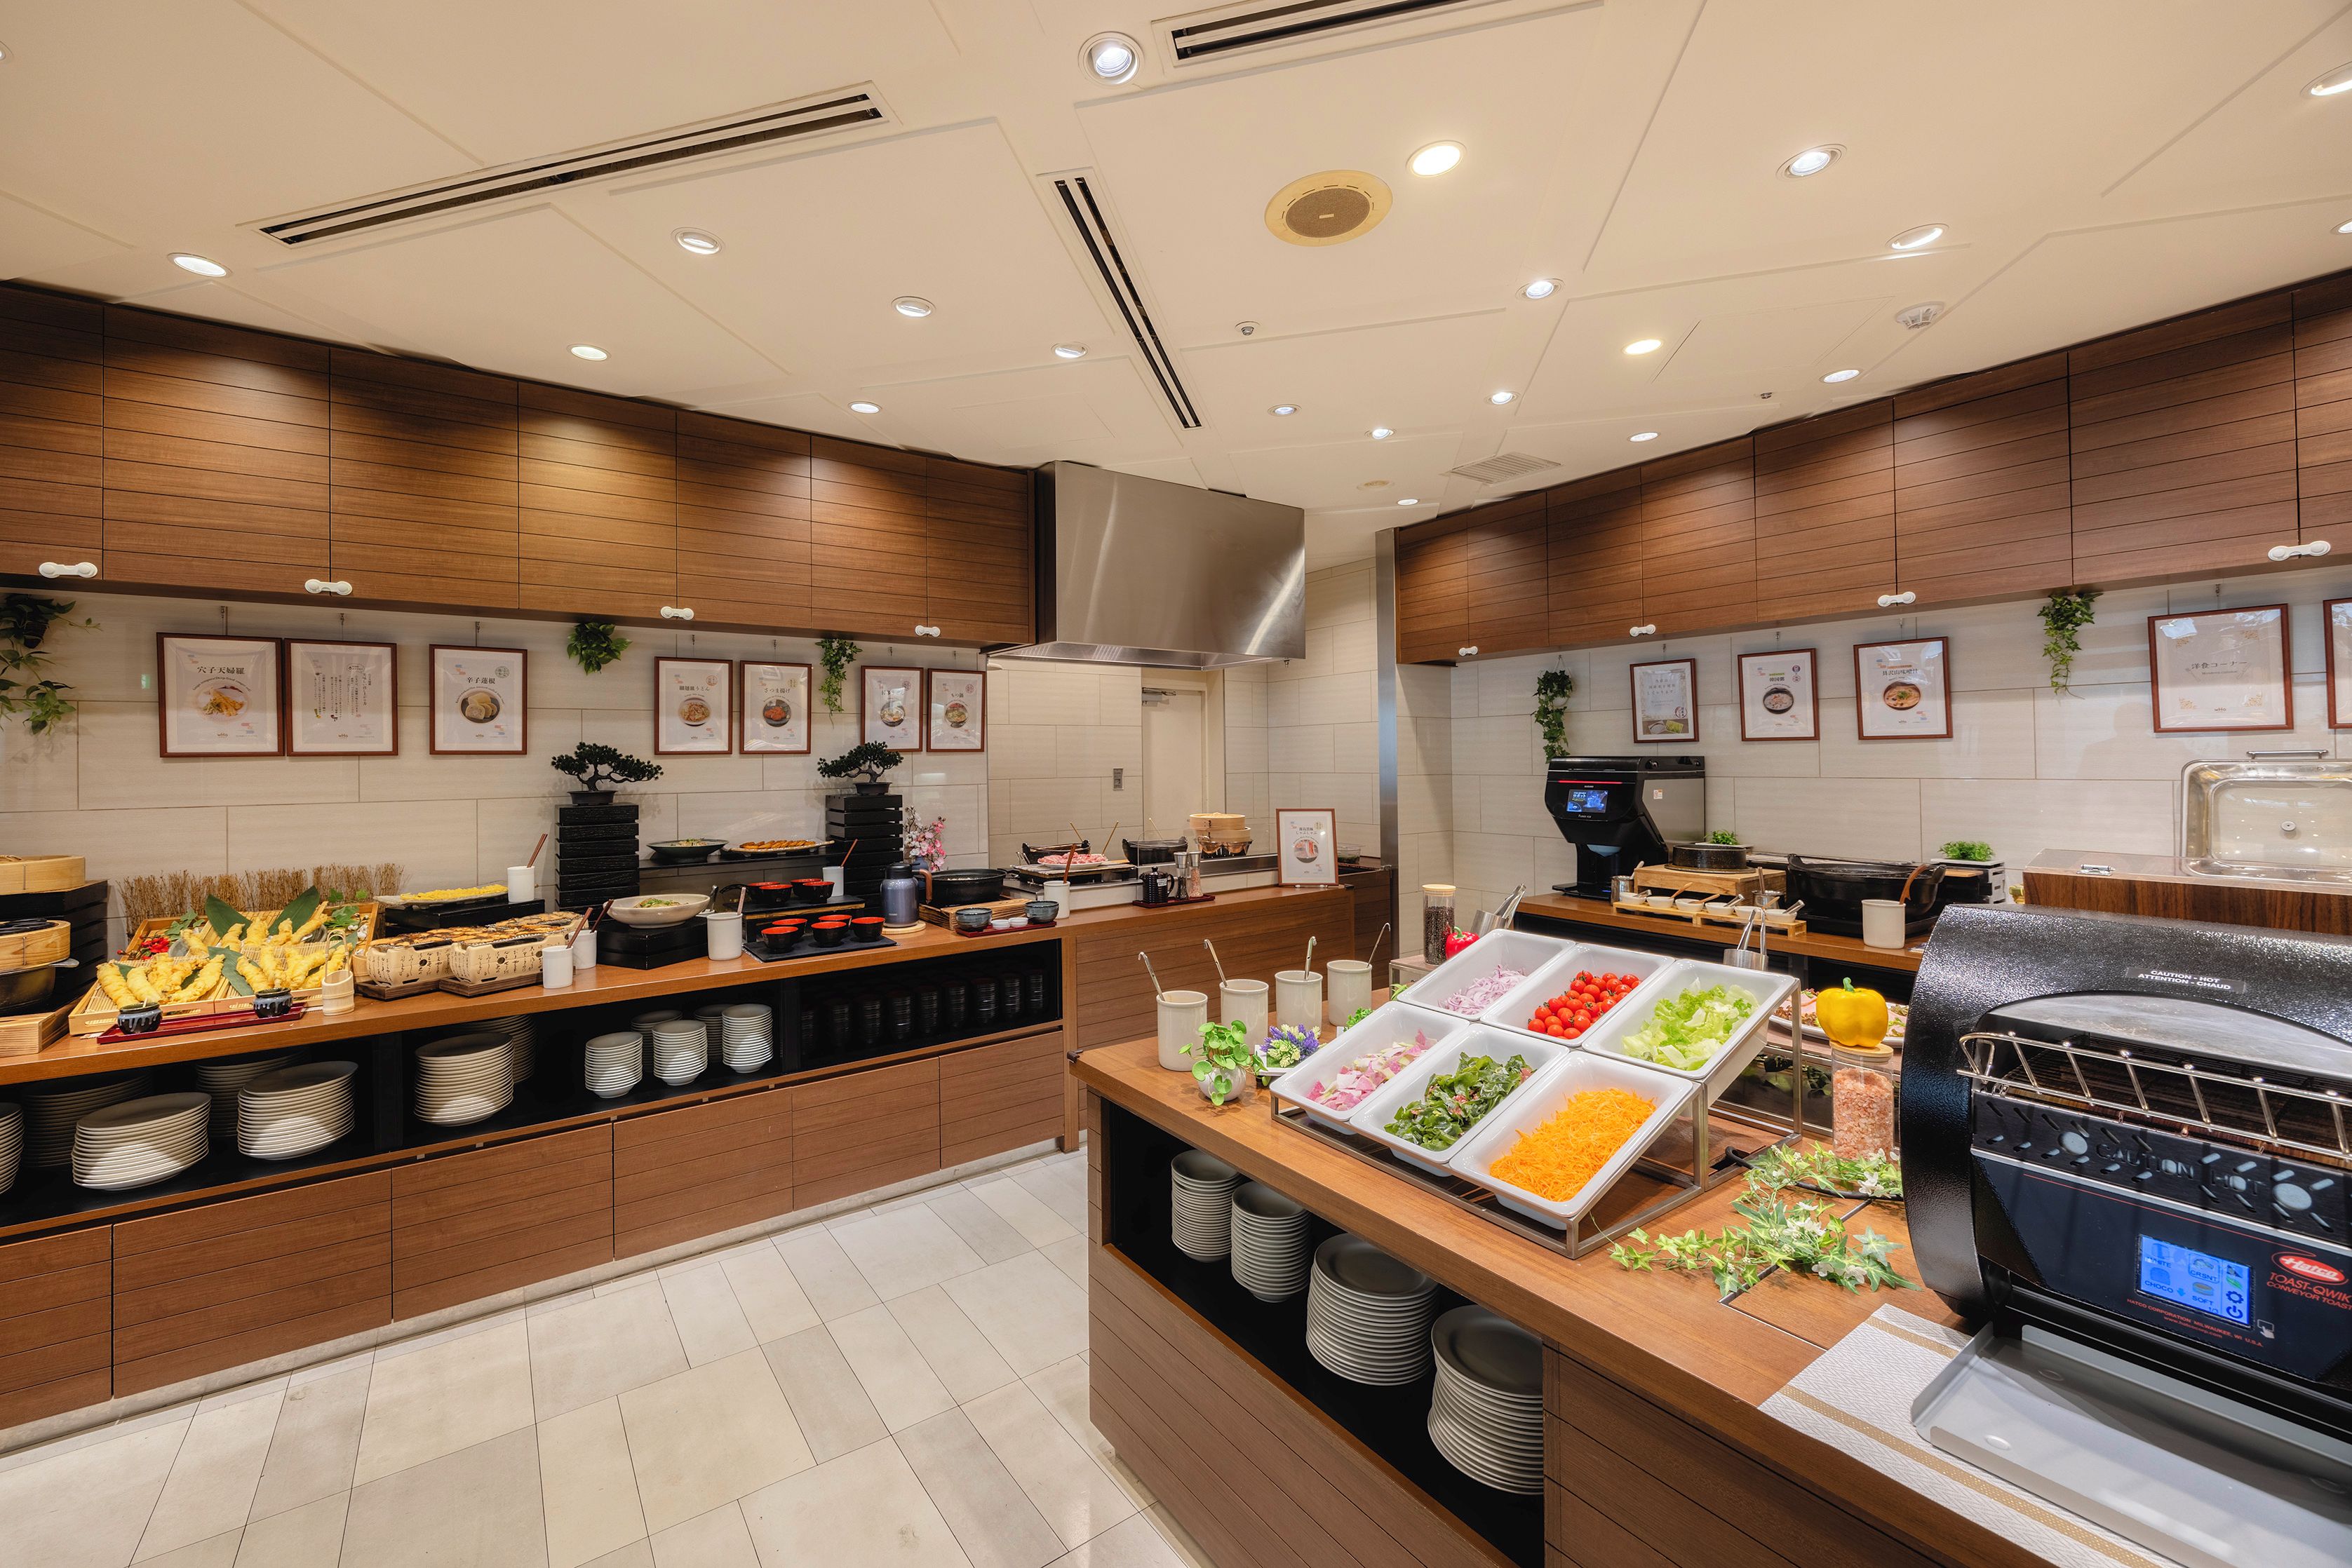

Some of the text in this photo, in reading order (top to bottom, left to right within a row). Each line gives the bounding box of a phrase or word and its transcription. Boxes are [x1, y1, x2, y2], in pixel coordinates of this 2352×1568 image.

[196, 665, 246, 675] 穴子天婦羅
[2191, 661, 2247, 670] 洋食コーナー
[467, 676, 496, 684] 辛子蓮根
[2137, 973, 2189, 985] ATTENTION
[2196, 980, 2232, 990] CHAUD
[2150, 971, 2191, 980] CAUTION
[2095, 1142, 2269, 1197] CAUTION HOT
[2146, 1256, 2172, 1269] WHITE
[2280, 1257, 2339, 1280] Hatco
[2190, 1269, 2218, 1283] CRSNT
[2144, 1280, 2174, 1294] CHOCO
[2266, 1280, 2320, 1302] CONVEYOR
[2269, 1271, 2352, 1304] TOAST-QWIK
[2191, 1295, 2215, 1306] SOFT
[2127, 1298, 2148, 1309] HATCO
[2147, 1304, 2192, 1324] CORPORATION
[2193, 1320, 2233, 1338] MILWAUKEE,
